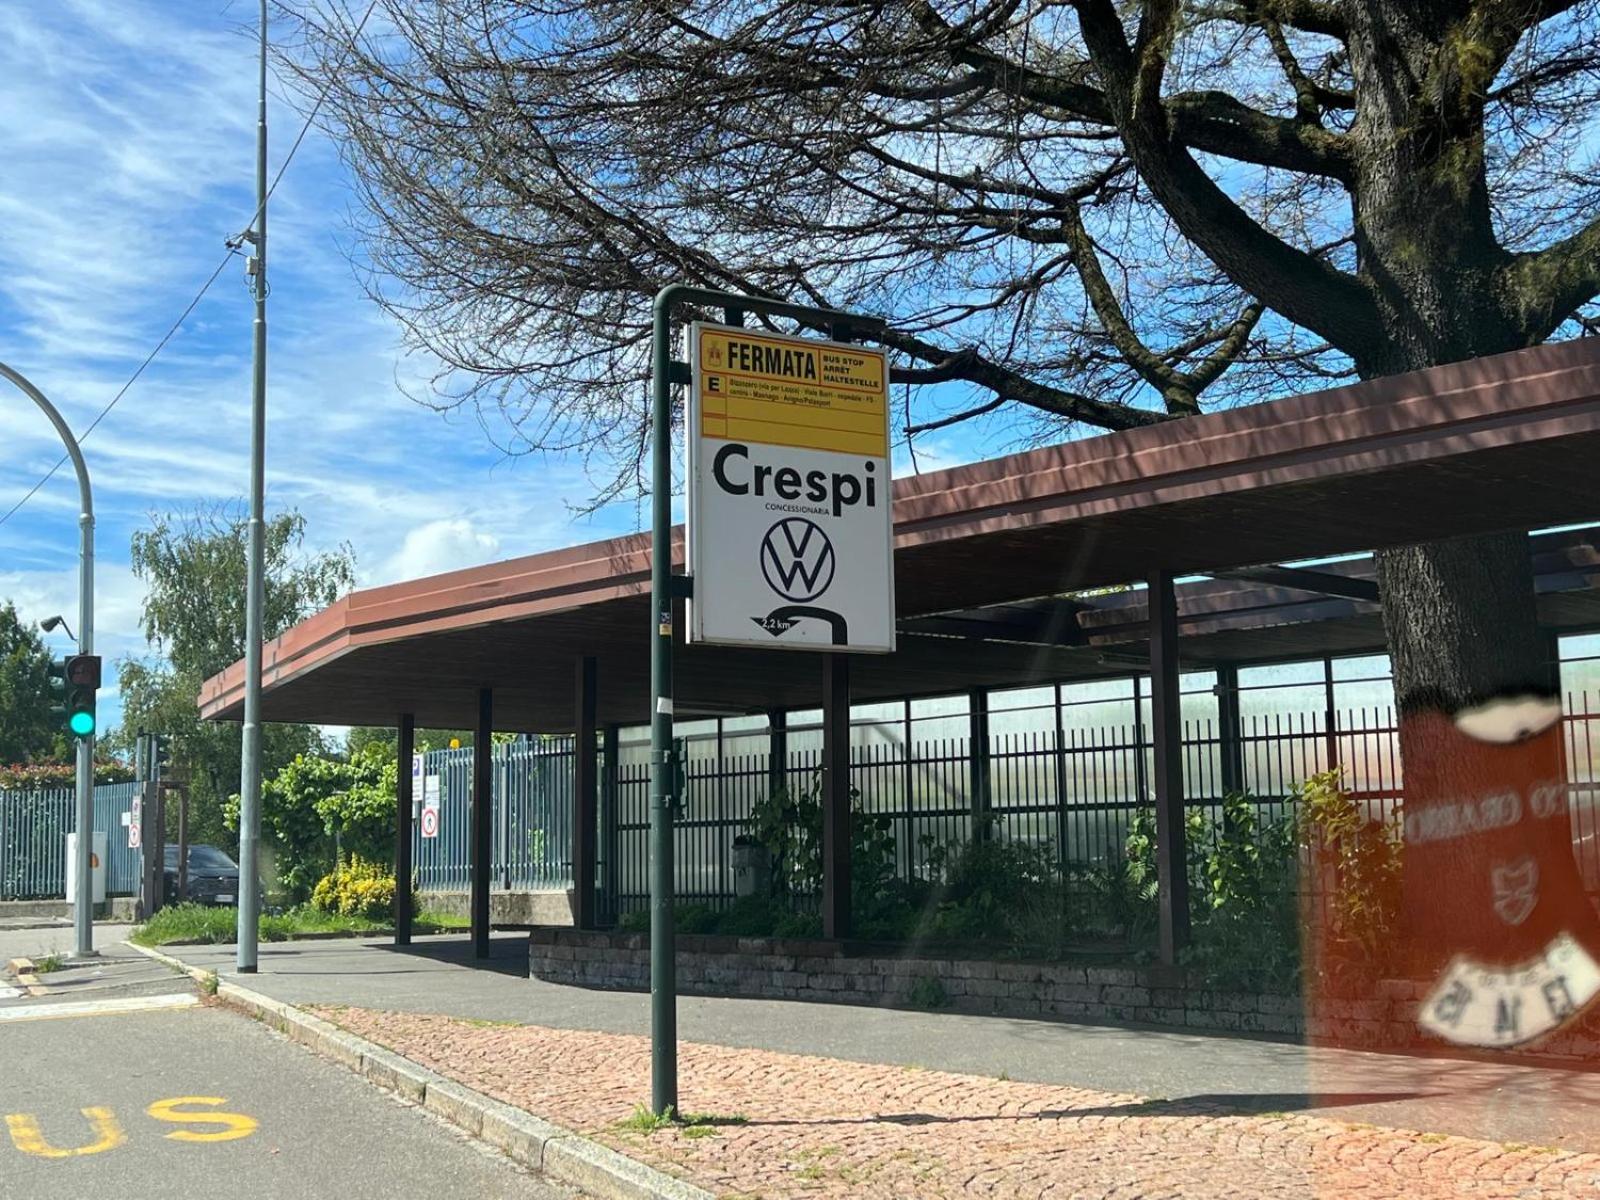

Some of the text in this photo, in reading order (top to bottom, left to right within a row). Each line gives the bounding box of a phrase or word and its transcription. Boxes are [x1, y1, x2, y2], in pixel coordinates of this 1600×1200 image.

[727, 341, 816, 380] FERMATA
[823, 355, 864, 366] BUS STOP
[708, 377, 720, 392] E
[823, 375, 879, 388] HALTESTELLE
[713, 443, 876, 517] Crespi
[765, 502, 830, 516] CONCESSIONARIA
[761, 618, 790, 630] 2,2 km
